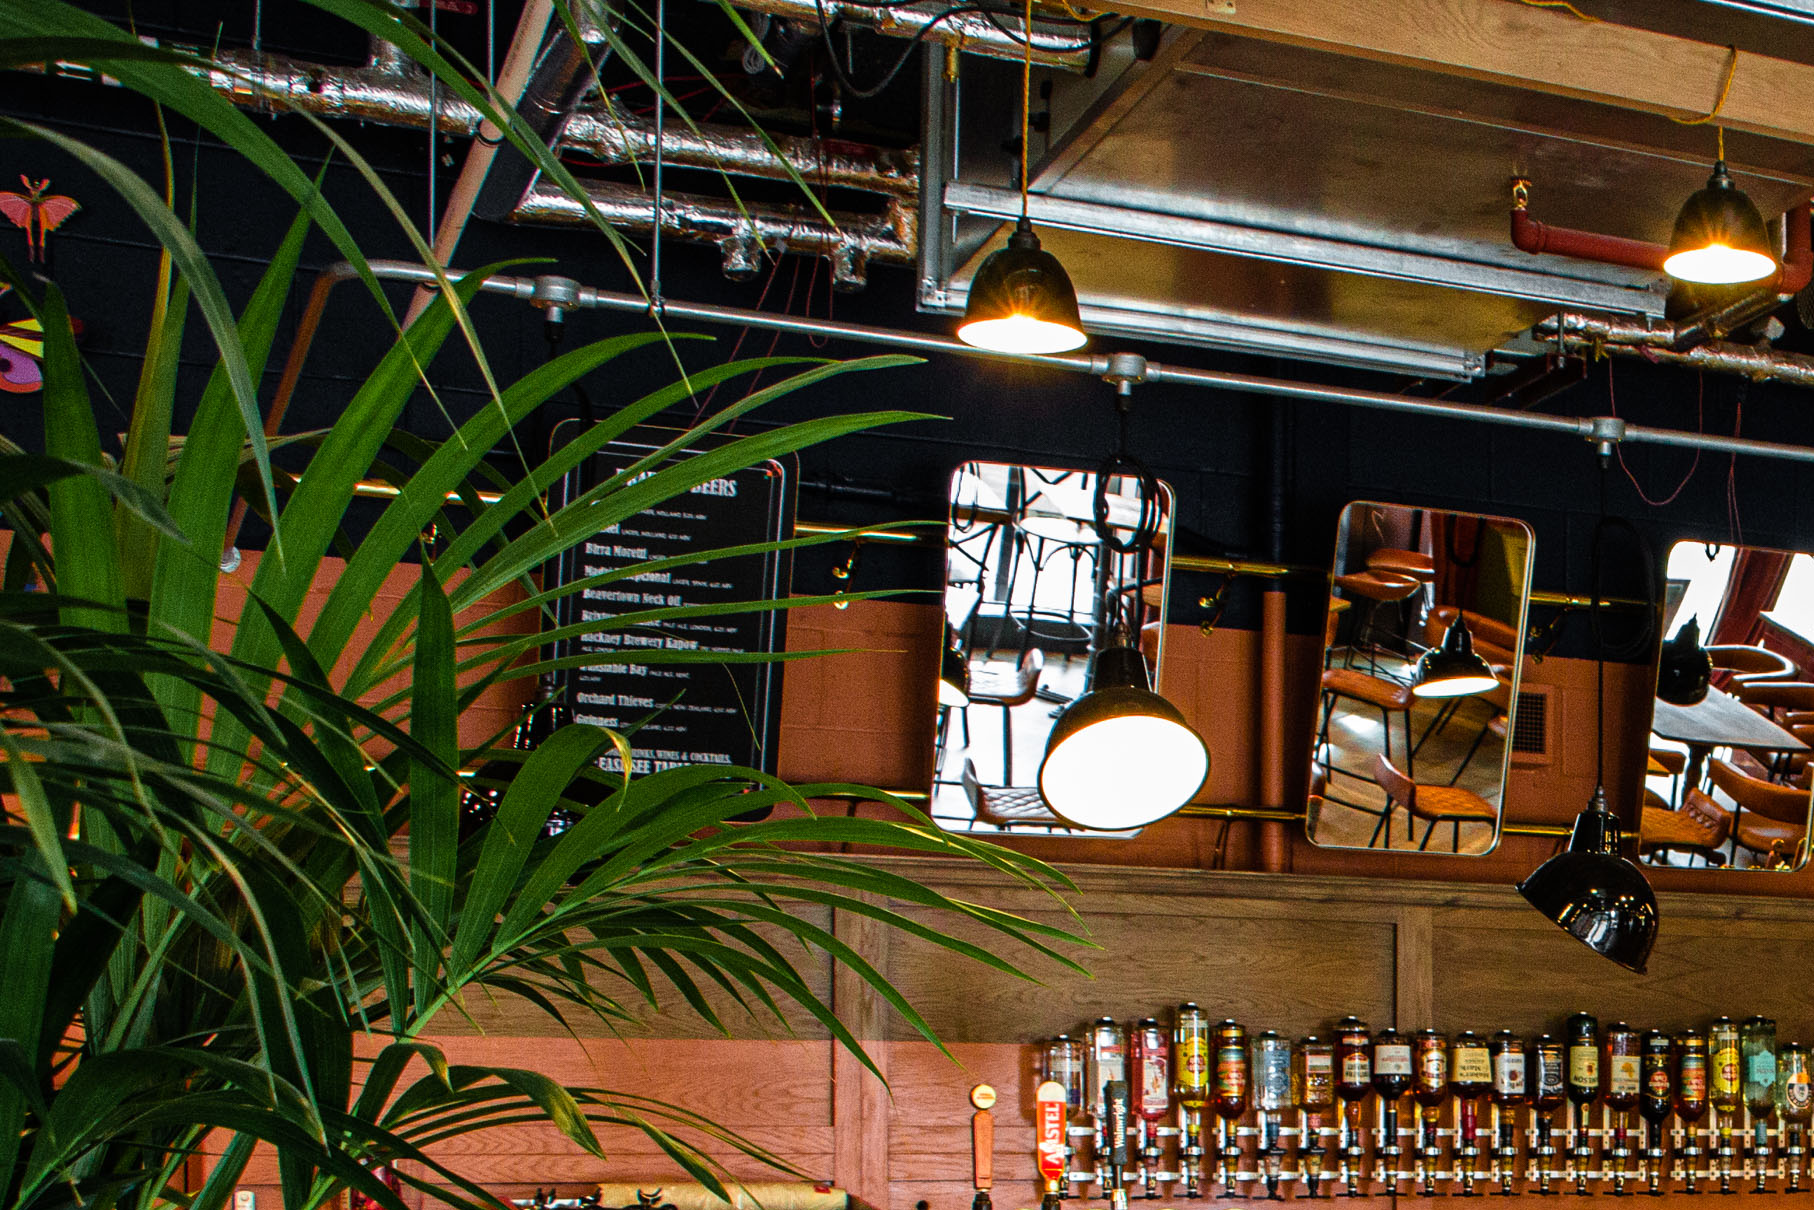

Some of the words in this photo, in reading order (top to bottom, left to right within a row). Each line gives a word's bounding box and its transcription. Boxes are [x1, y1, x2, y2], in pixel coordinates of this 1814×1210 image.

[585, 542, 612, 556] Birra
[613, 545, 648, 559] Moretti
[583, 588, 641, 604] Beavertown
[642, 592, 666, 606] Neck
[667, 595, 682, 607] Oil
[580, 632, 622, 646] Hackney
[624, 634, 664, 649] Brewery
[665, 637, 698, 650] Kapow
[629, 664, 648, 677] Bay
[577, 691, 616, 706] Orchard
[618, 694, 654, 708] Thieves
[575, 713, 618, 728] Guinness
[656, 749, 680, 761] WINES
[681, 751, 688, 761] &
[632, 760, 651, 774] SEE
[1113, 1098, 1126, 1148] Wainwright
[1045, 1103, 1060, 1164] AMSTEL
